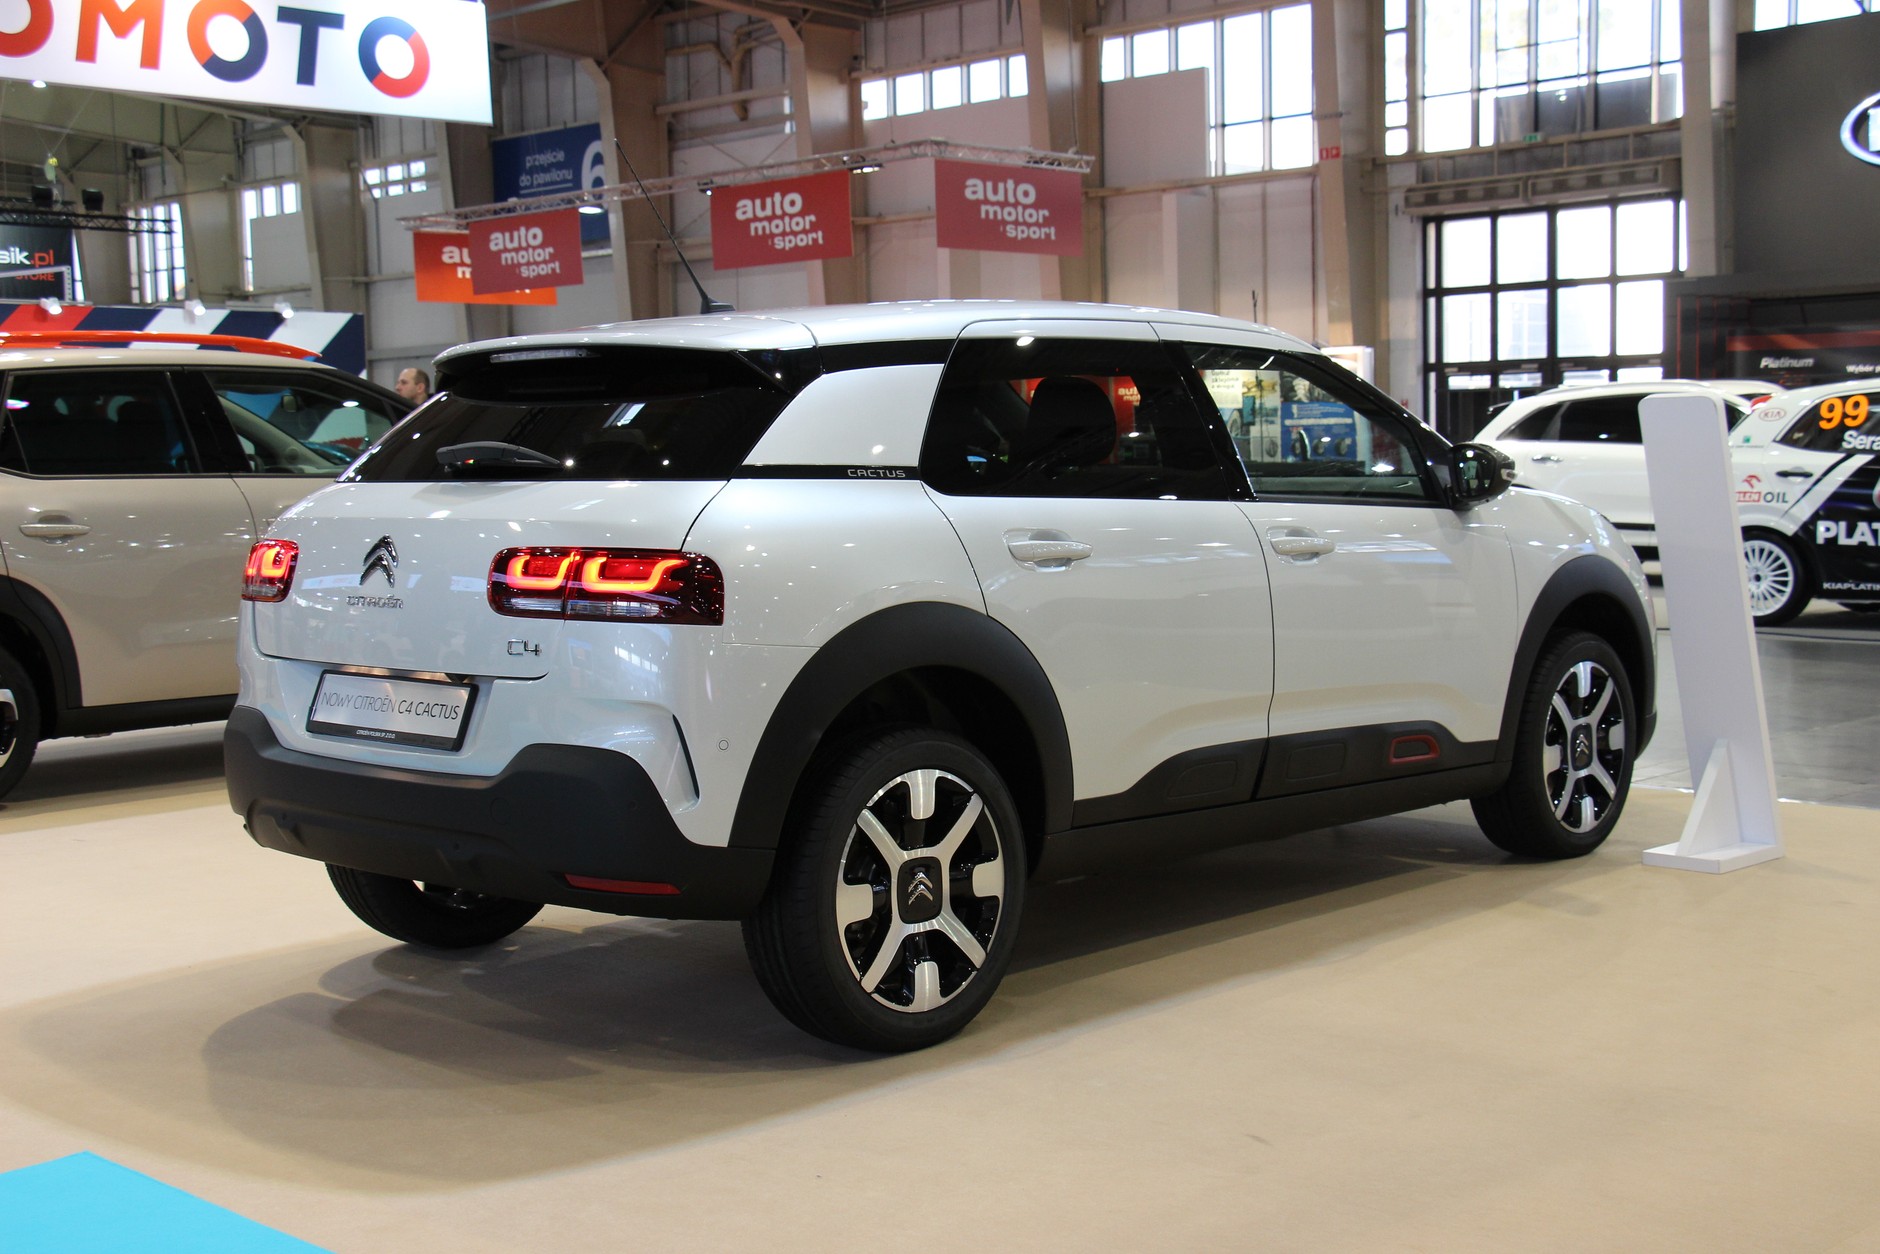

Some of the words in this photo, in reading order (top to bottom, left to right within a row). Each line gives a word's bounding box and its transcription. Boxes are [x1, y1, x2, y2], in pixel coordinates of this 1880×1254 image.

[526, 149, 565, 168] przejście
[519, 172, 532, 187] do
[533, 168, 573, 186] pawilonu
[964, 178, 1036, 205] auto
[735, 192, 803, 221] auto
[980, 204, 1049, 223] motor
[750, 214, 816, 236] motor
[1006, 224, 1056, 240] sport
[489, 226, 543, 251] auto
[773, 230, 824, 250] sport
[501, 246, 554, 265] motor
[520, 261, 560, 278] sport
[1760, 357, 1815, 368] Platinum
[1763, 410, 1781, 418] KIA
[1818, 394, 1869, 430] 99
[847, 469, 906, 478] CACTUS
[1763, 491, 1789, 503] OIL
[507, 638, 543, 656] C4
[321, 692, 354, 706] NOWY
[353, 695, 397, 713] CITROËN
[397, 699, 413, 714] C4
[415, 702, 460, 720] CACTUS
